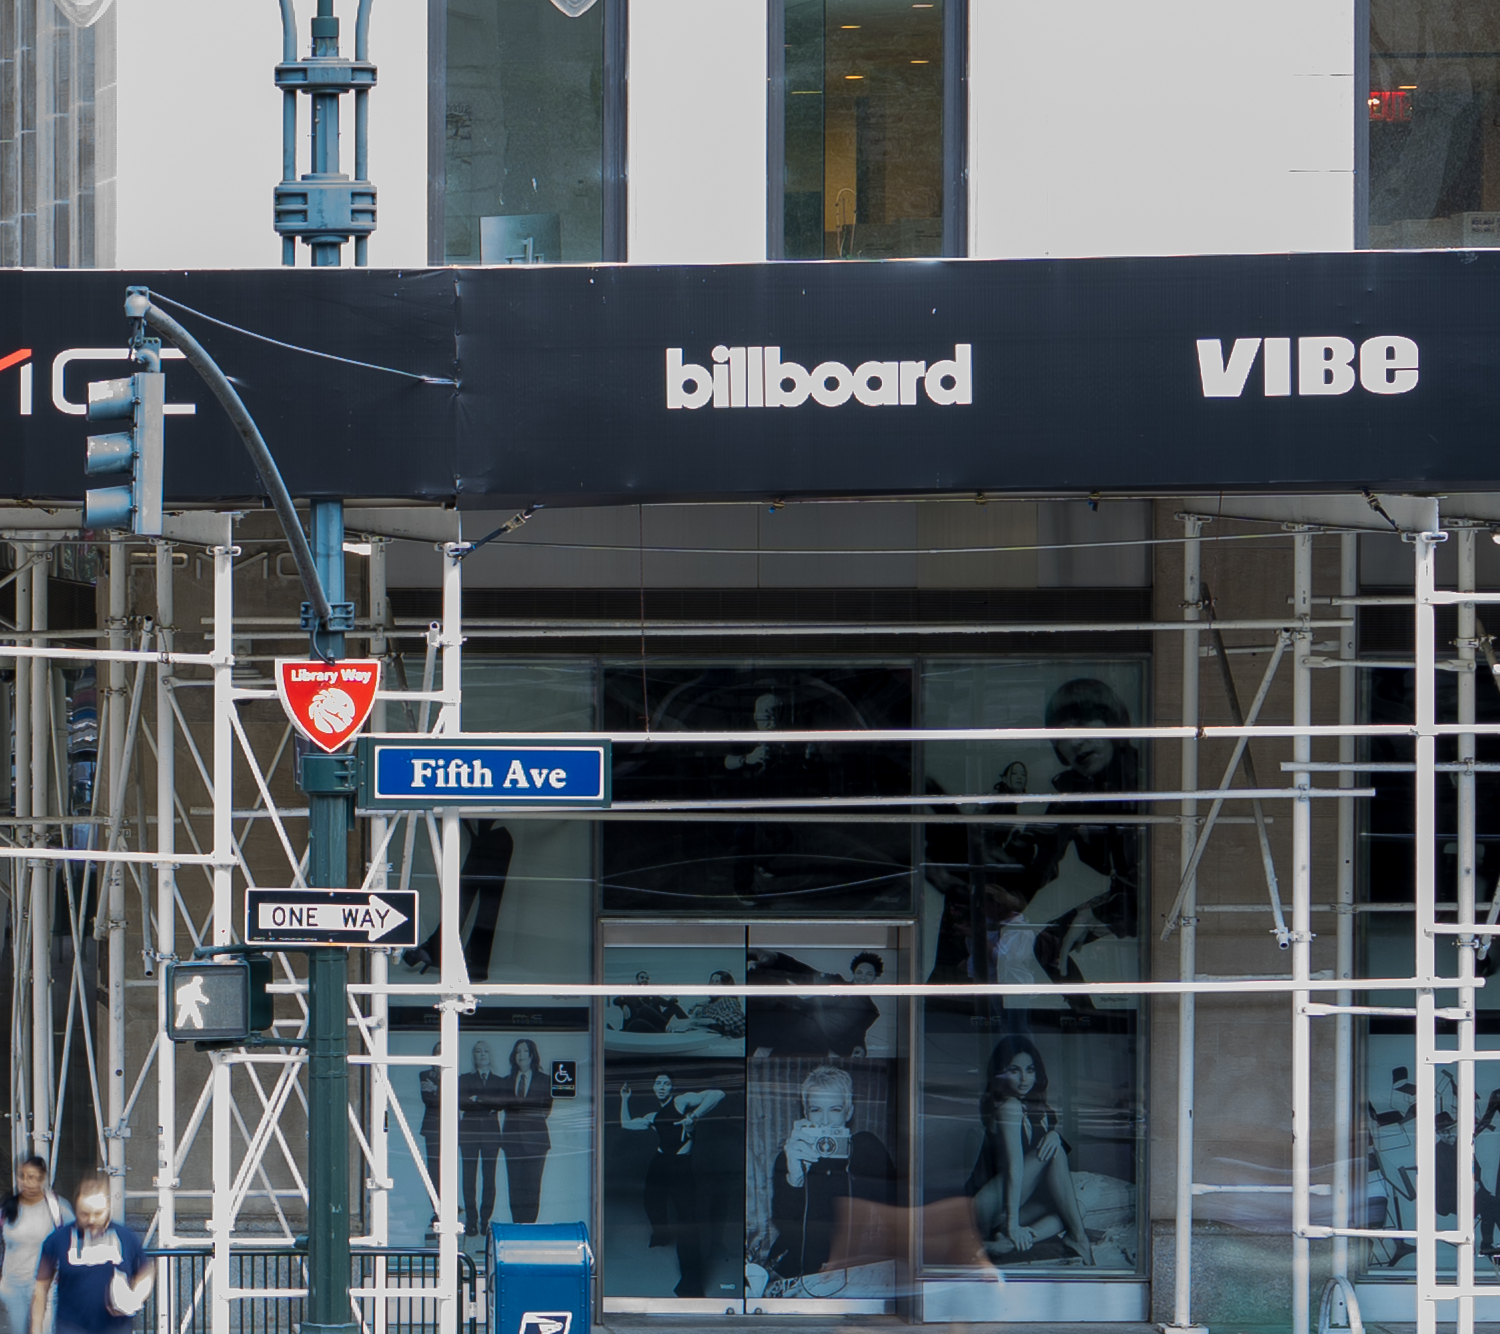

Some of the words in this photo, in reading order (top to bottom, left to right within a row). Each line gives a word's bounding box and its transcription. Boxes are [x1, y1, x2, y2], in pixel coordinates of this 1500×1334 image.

[666, 344, 972, 409] billboard
[1197, 336, 1418, 397] VIBE
[291, 668, 338, 684] Library
[341, 668, 372, 684] Way
[411, 759, 493, 788] Fifth
[503, 760, 566, 788] Ave
[272, 906, 318, 927] ONE
[342, 907, 390, 928] WAY
